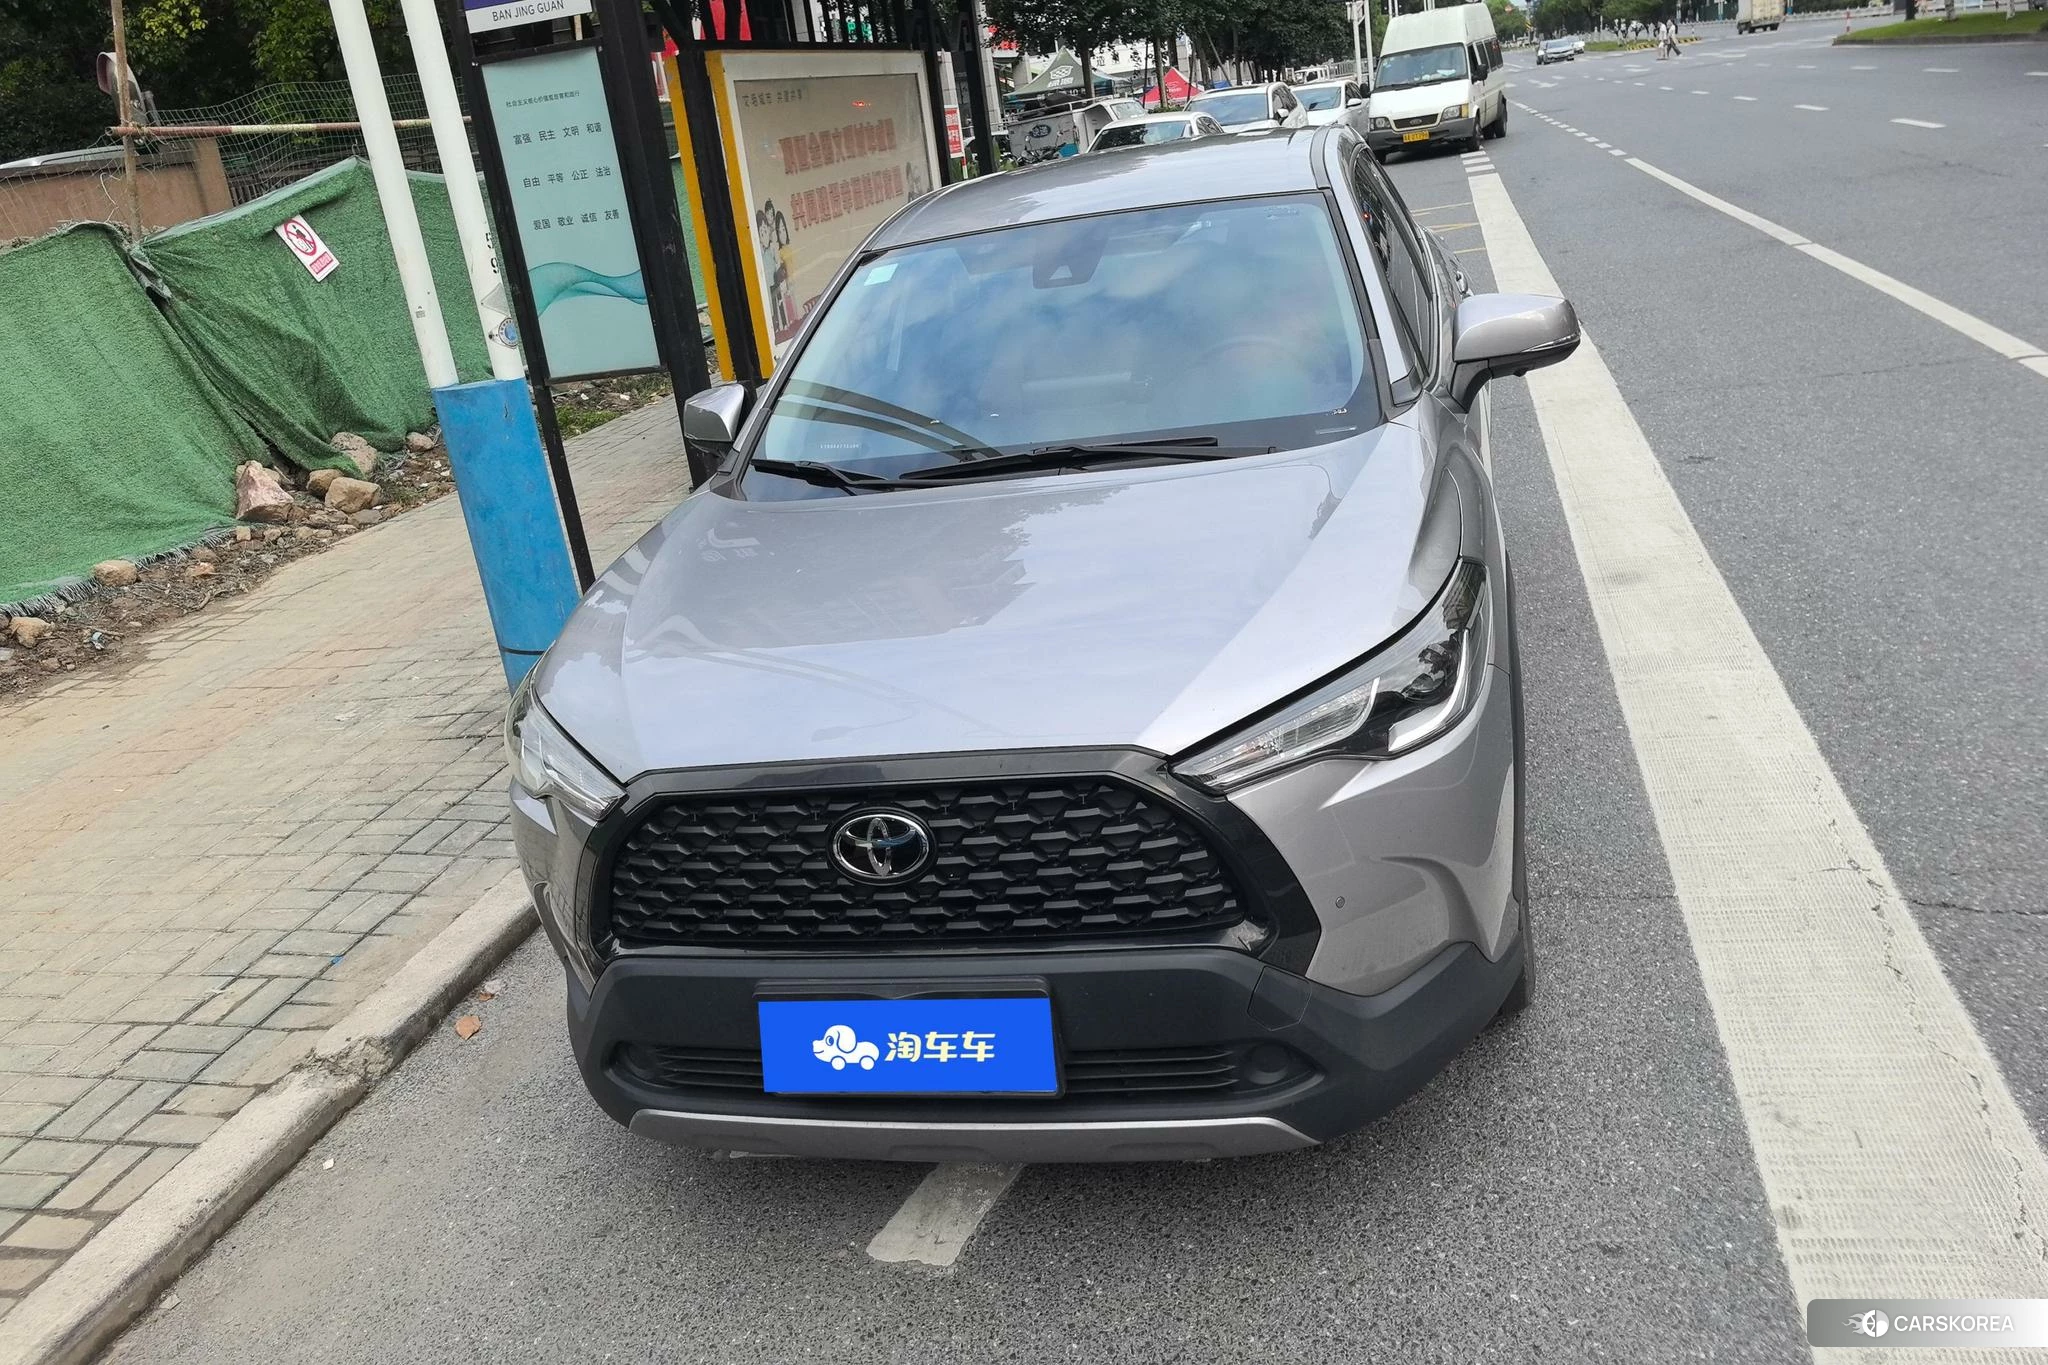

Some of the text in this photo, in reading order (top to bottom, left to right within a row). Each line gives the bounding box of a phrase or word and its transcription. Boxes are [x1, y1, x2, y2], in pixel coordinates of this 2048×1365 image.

[492, 0, 565, 21] BAN JING GUAN
[513, 122, 602, 145] 富强 民主 文明 和谐
[523, 165, 611, 188] 自由 平等 公正 法治
[533, 209, 620, 230] 爱国 敬业 诚信 友善
